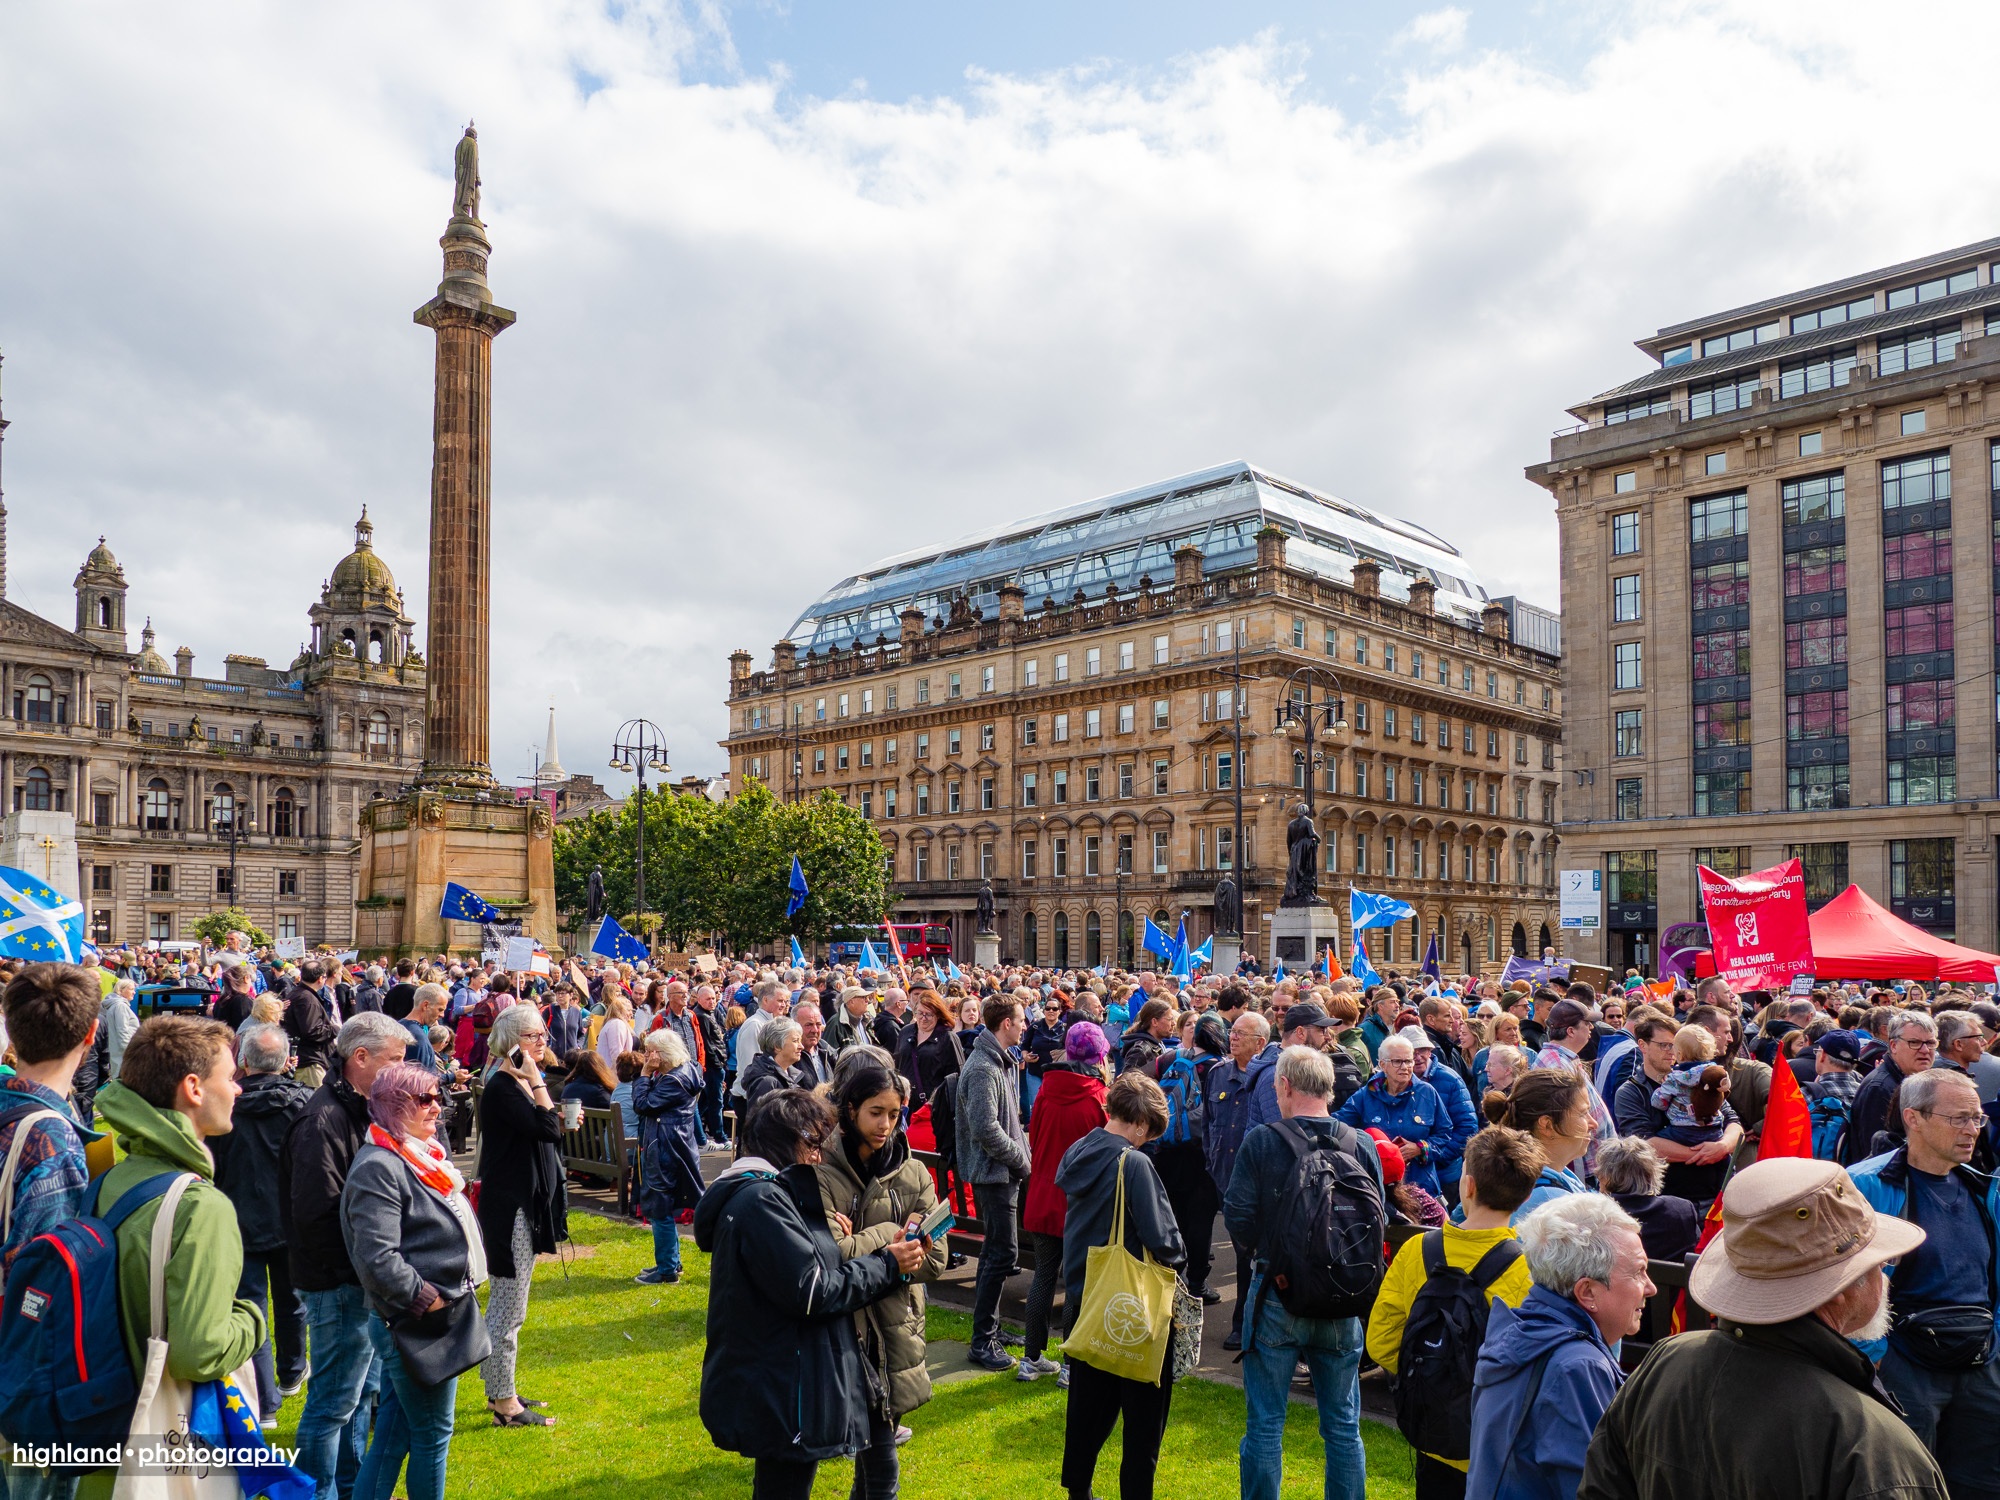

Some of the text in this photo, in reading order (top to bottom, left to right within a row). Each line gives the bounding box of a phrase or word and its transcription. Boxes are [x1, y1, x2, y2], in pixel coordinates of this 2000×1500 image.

[1730, 952, 1775, 967] REAL CHANGE
[1727, 969, 1738, 980] THE
[1738, 967, 1757, 978] MANY
[1757, 965, 1771, 975] NOT
[1773, 963, 1785, 973] THE
[1788, 960, 1808, 971] FEW
[1089, 1337, 1145, 1361] SANTO SPIRITO
